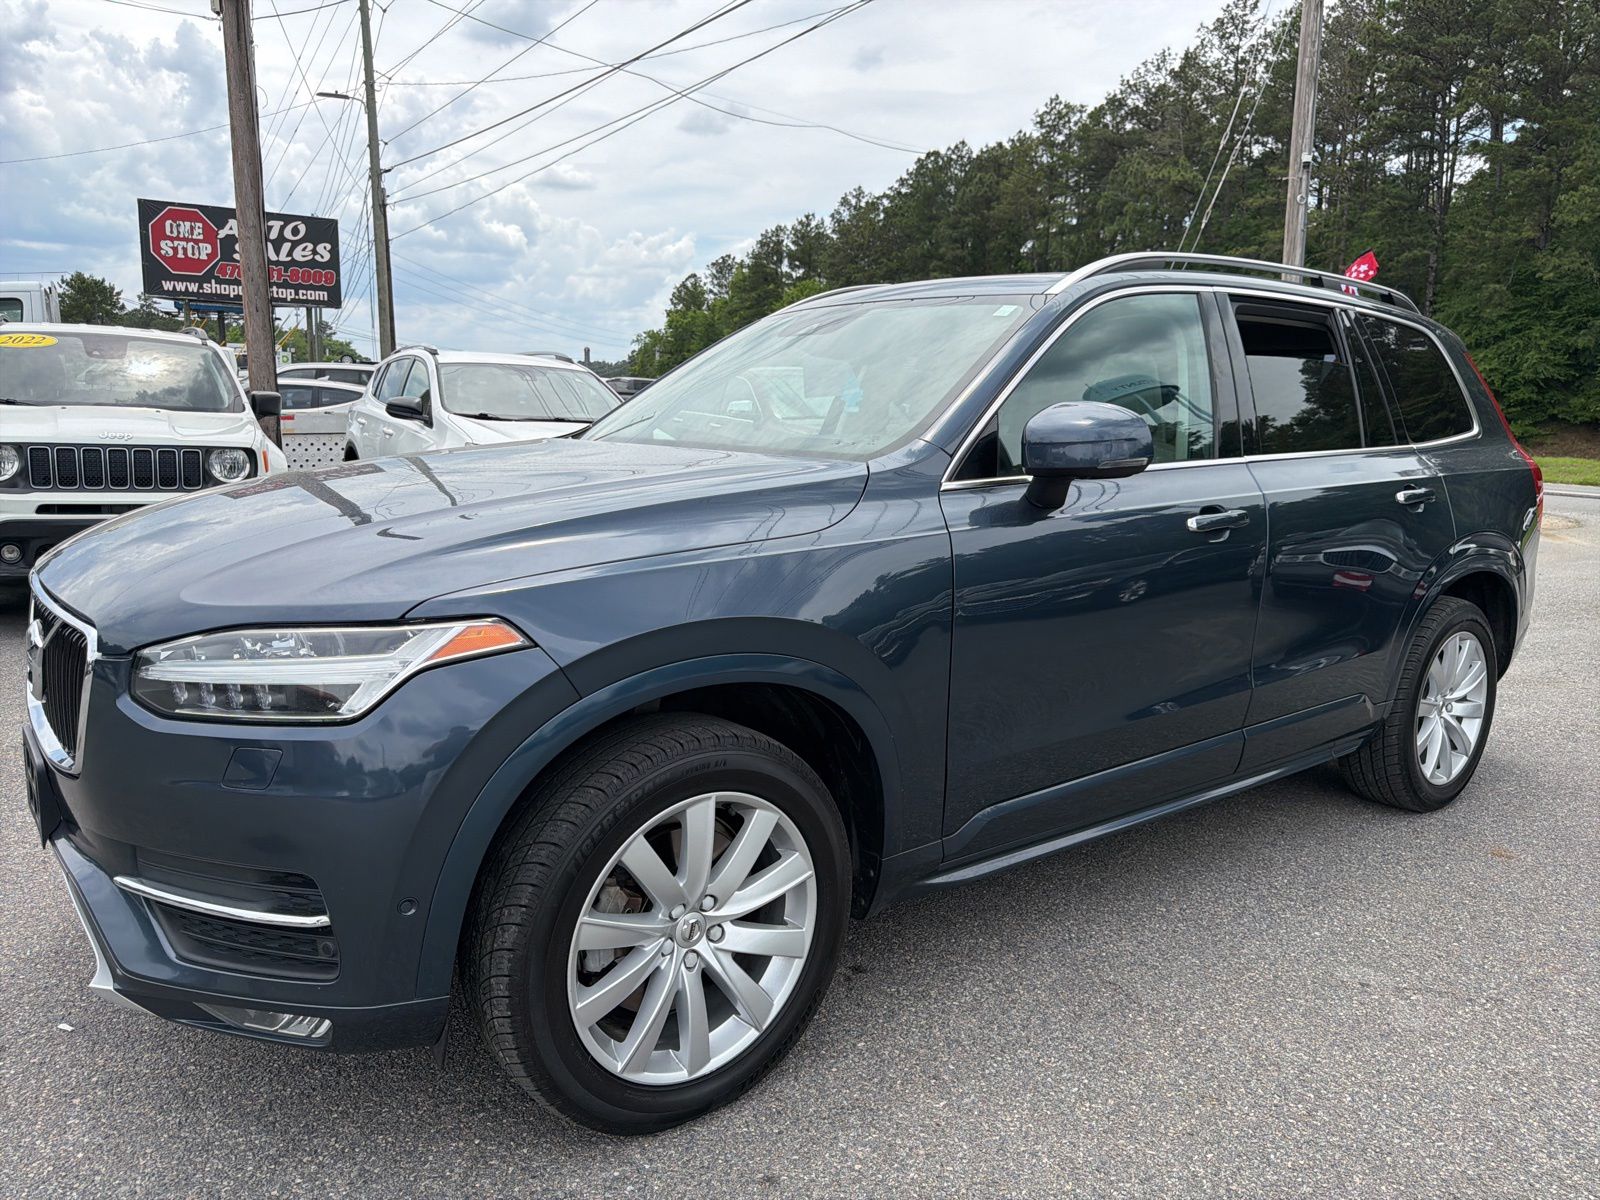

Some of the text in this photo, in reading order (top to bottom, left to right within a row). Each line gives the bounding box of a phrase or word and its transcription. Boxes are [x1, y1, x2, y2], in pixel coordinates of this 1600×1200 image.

[165, 219, 204, 240] ONE
[217, 219, 307, 240] ATO
[160, 240, 212, 260] STOP
[161, 279, 328, 301] www.shoptop.com
[0, 336, 46, 344] 2022
[98, 431, 133, 441] Jeep
